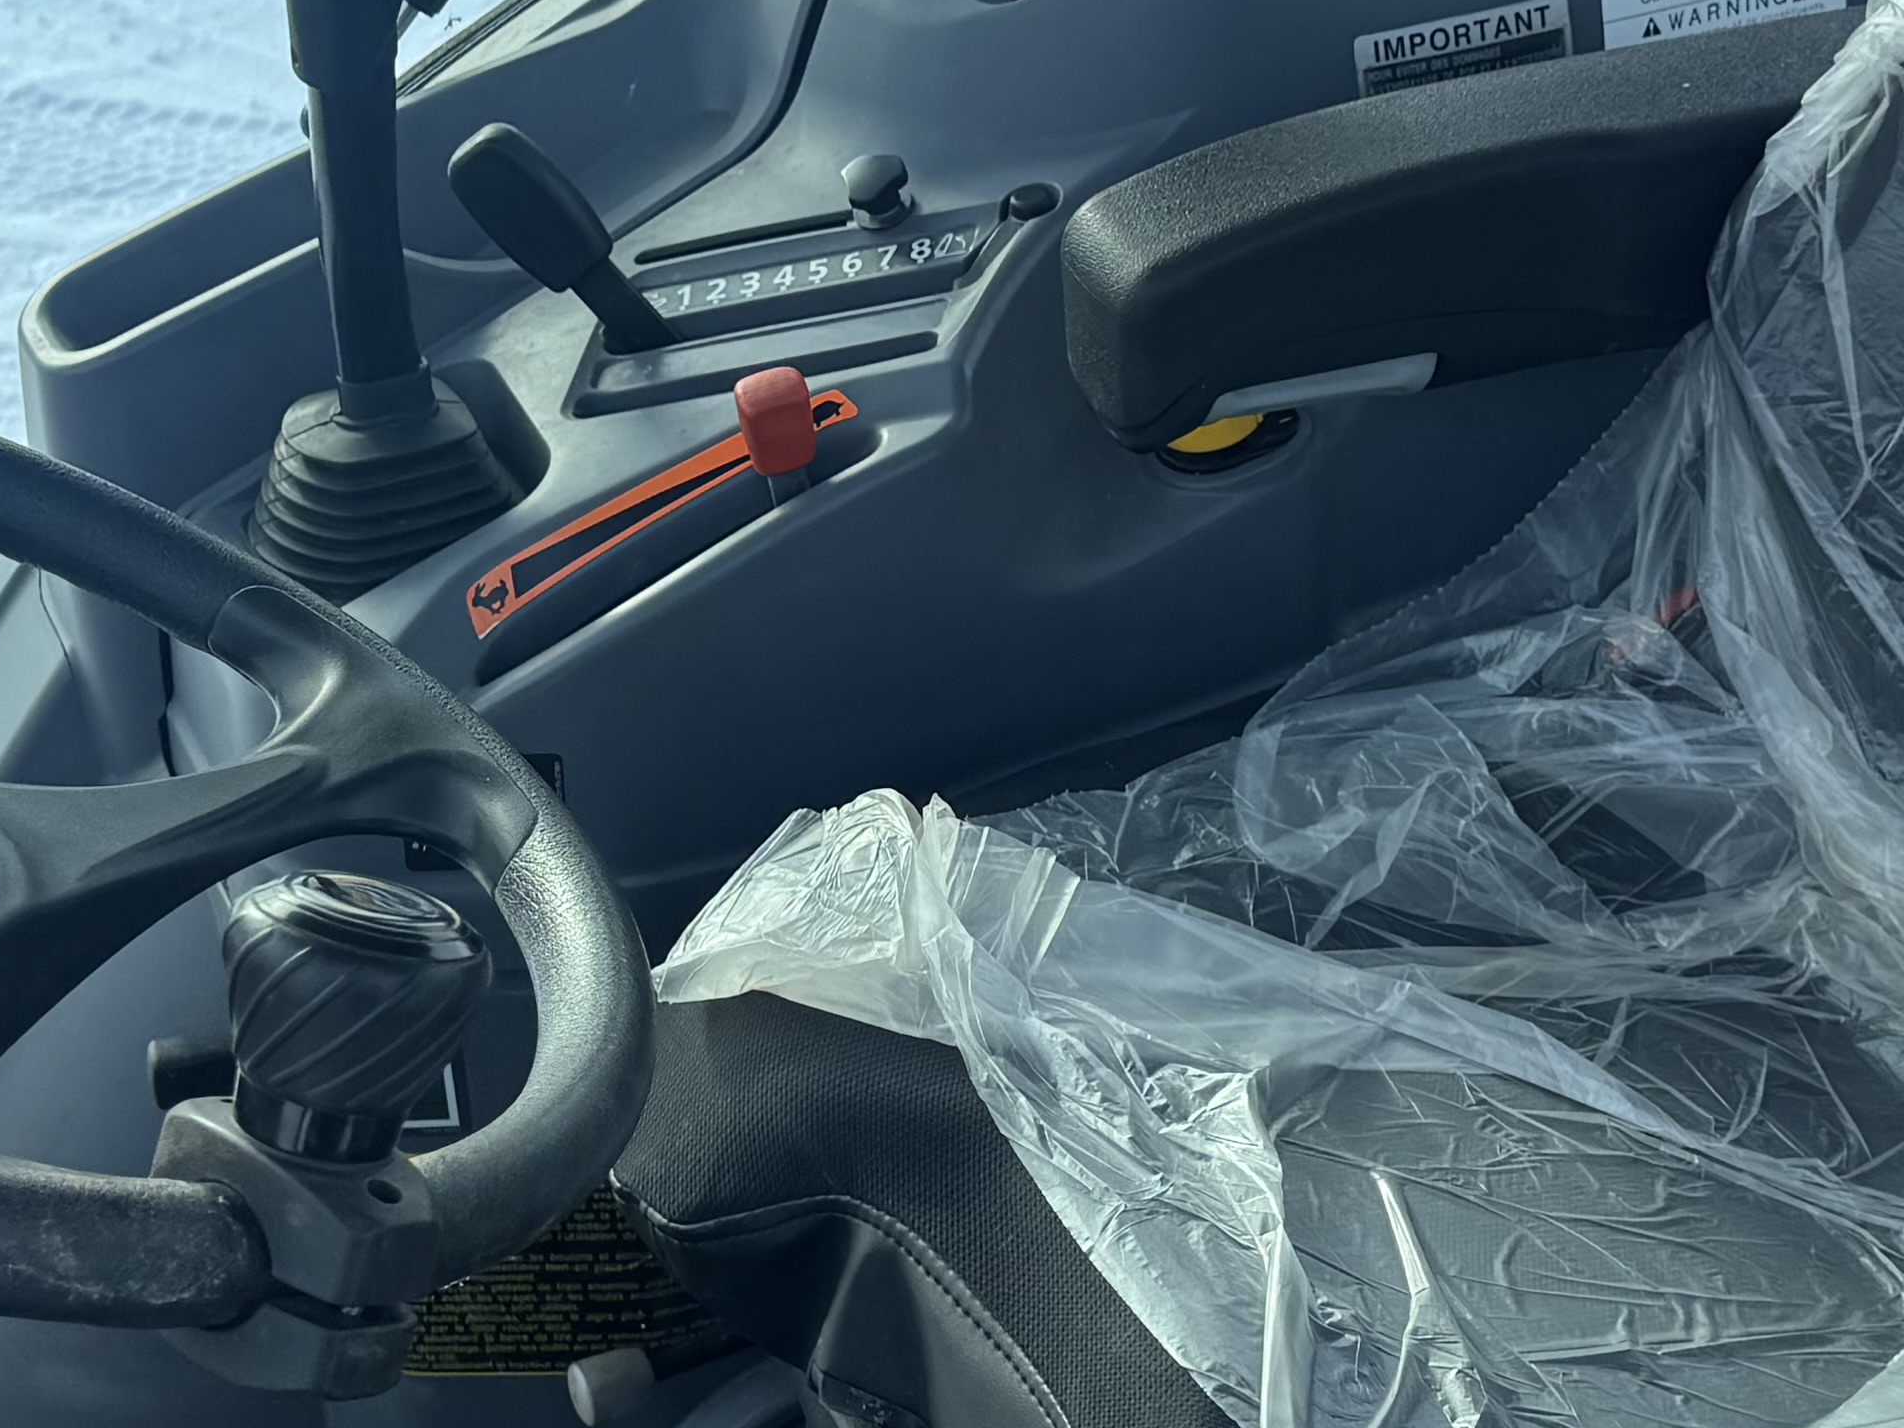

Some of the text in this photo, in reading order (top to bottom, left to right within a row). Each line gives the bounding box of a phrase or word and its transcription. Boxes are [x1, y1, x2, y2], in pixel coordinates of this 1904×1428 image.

[1373, 5, 1550, 63] IMPORTANT
[677, 238, 931, 305] 1 2 3 4 5 6 7 8
